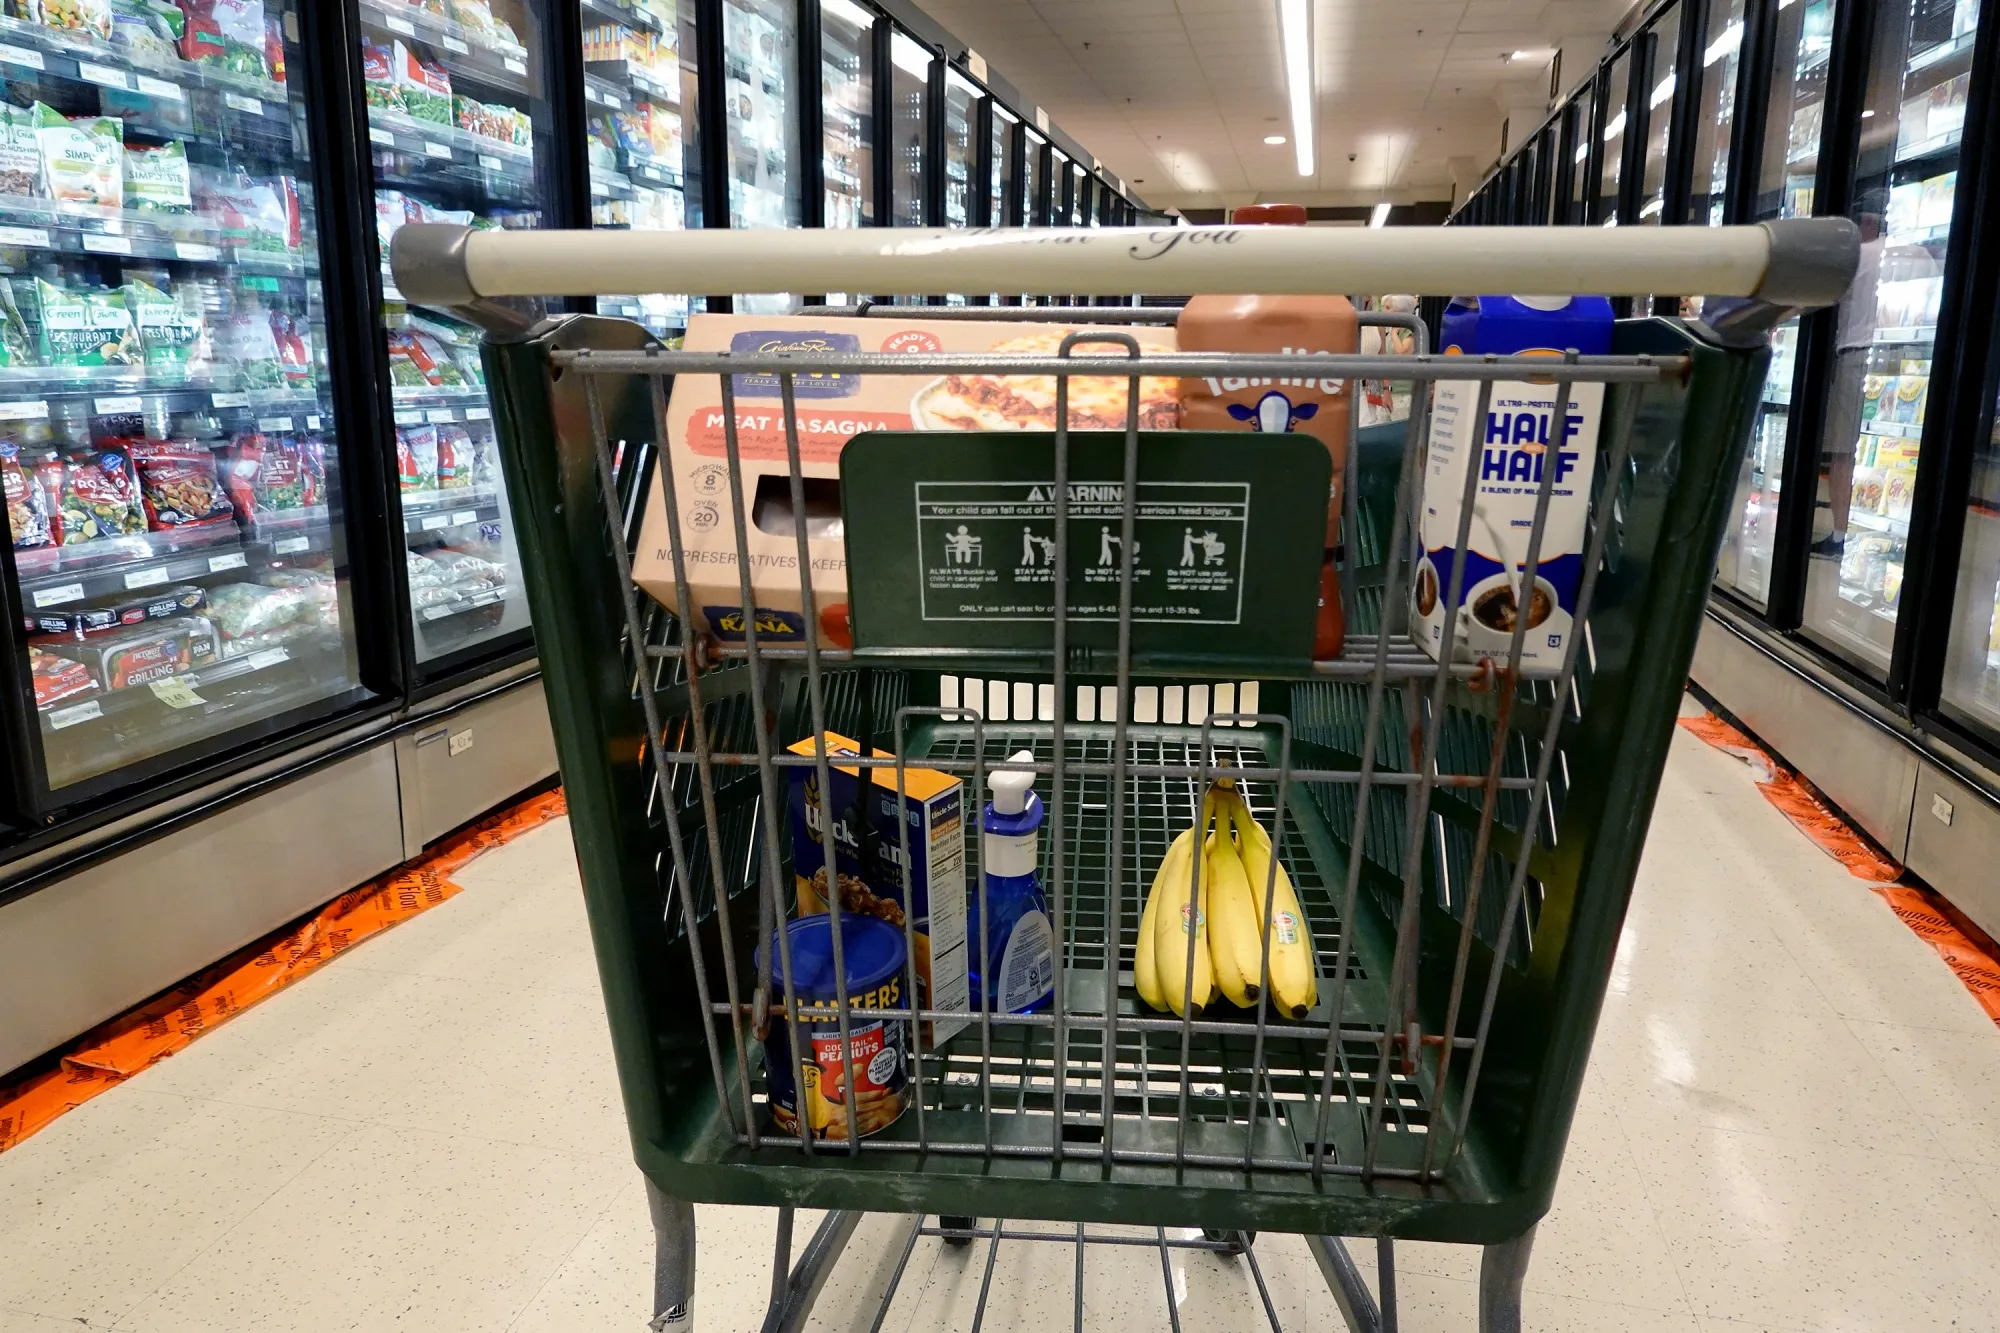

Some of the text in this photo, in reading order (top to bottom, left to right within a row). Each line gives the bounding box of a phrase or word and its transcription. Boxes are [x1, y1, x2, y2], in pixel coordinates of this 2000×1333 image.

[46, 308, 81, 319] Green
[889, 334, 926, 351] READY
[925, 337, 937, 351] IN
[777, 417, 888, 435] LASAGNA
[1485, 411, 1585, 447] HALF
[689, 463, 732, 478] MICROWAV
[1481, 449, 1580, 484] HALF
[705, 474, 716, 485] 8
[1047, 486, 1125, 502] WARNIN
[693, 499, 719, 508] OVEN
[694, 512, 713, 522] 20
[931, 506, 954, 516] Your
[956, 506, 979, 516] child
[981, 507, 999, 516] can
[1000, 506, 1015, 516] fall
[1017, 507, 1032, 516] out
[1034, 506, 1045, 515] of
[1046, 507, 1057, 515] th
[1068, 507, 1082, 515] art
[1083, 506, 1102, 515] and
[1104, 506, 1124, 515] suffe
[1140, 507, 1177, 517] serious
[1177, 506, 1203, 516] head
[1203, 507, 1232, 519] injury.
[684, 550, 797, 569] PRESERATIVES
[929, 568, 962, 576] ALWAYS
[1014, 568, 1035, 576] STAY
[959, 605, 983, 613] ONLY
[1000, 606, 1016, 614] cart
[1017, 606, 1034, 614] seat
[1034, 605, 1046, 614] for
[1077, 607, 1098, 616] ages
[1147, 606, 1164, 615] and
[1165, 606, 1188, 615] 15-35
[192, 642, 211, 655] PAN
[126, 663, 174, 686] GRILLING
[805, 802, 859, 849] Ucle
[878, 841, 912, 869] am
[819, 1041, 879, 1062] PEAUTS
[825, 1036, 874, 1052] COCTAIL™
